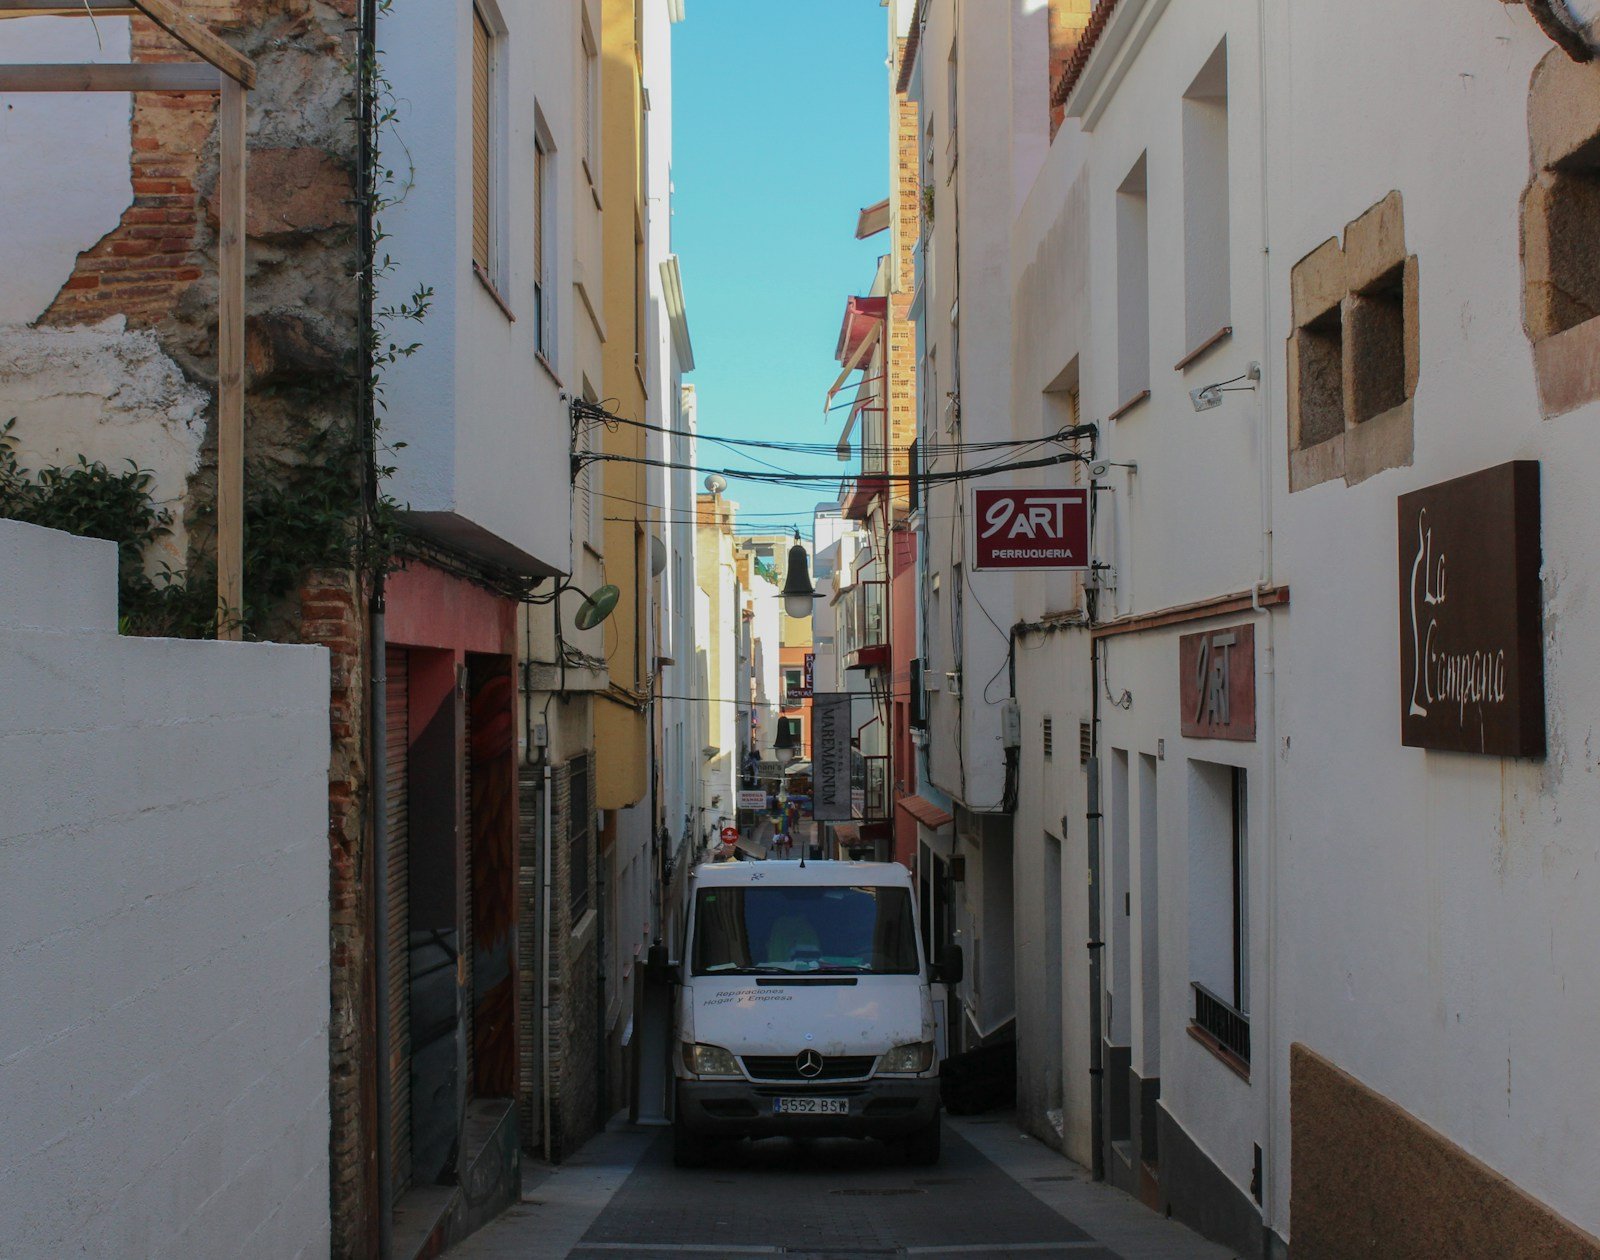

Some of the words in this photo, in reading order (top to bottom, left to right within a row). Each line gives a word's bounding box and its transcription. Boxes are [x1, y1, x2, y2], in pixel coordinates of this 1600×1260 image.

[991, 549, 1073, 559] PERRUQUERIA
[806, 655, 814, 689] HOTEL
[1424, 618, 1505, 728] Campana
[821, 708, 836, 806] MAREMAGNUM
[716, 989, 784, 998] Reparaciones
[703, 997, 734, 1007] Hogar
[781, 1099, 816, 1112] 5552
